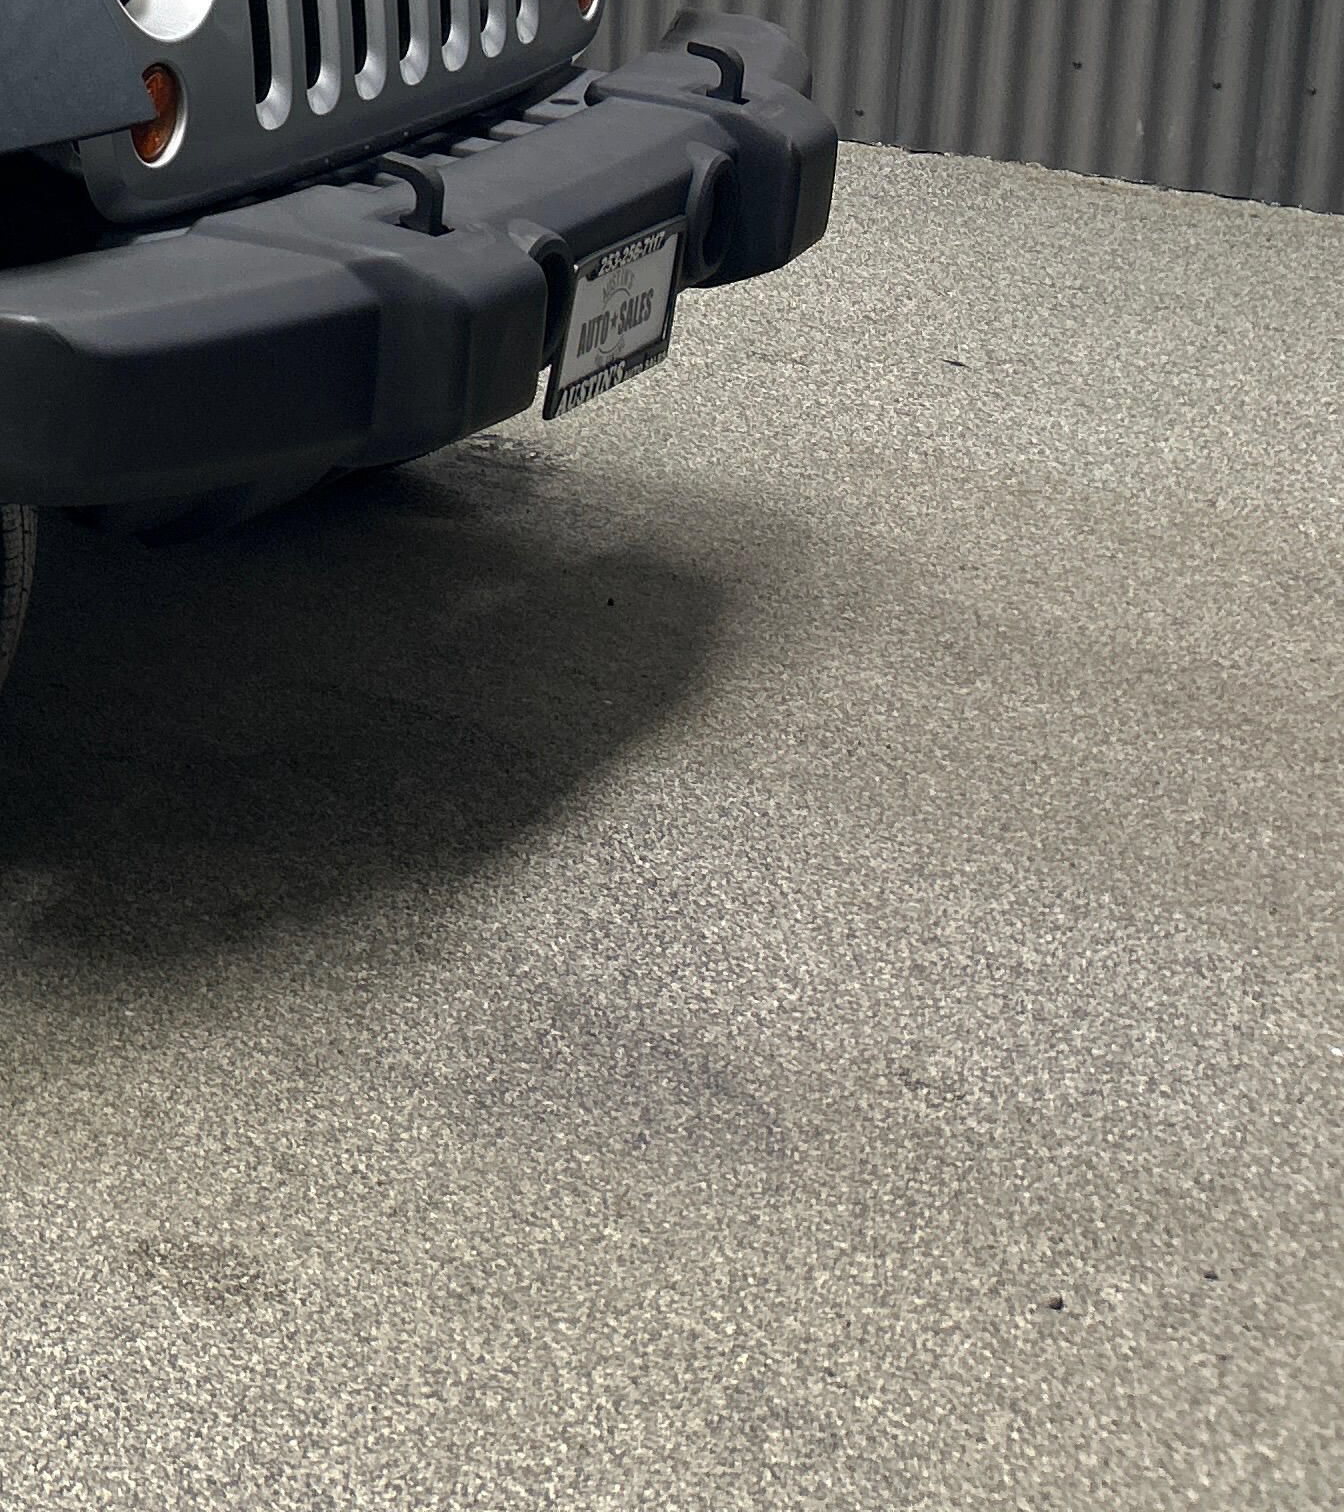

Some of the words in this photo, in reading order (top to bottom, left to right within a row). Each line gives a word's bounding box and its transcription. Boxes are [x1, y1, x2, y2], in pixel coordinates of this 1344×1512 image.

[576, 310, 611, 358] AUTO
[617, 287, 655, 336] SALES
[554, 359, 627, 418] AUSTIN'S
